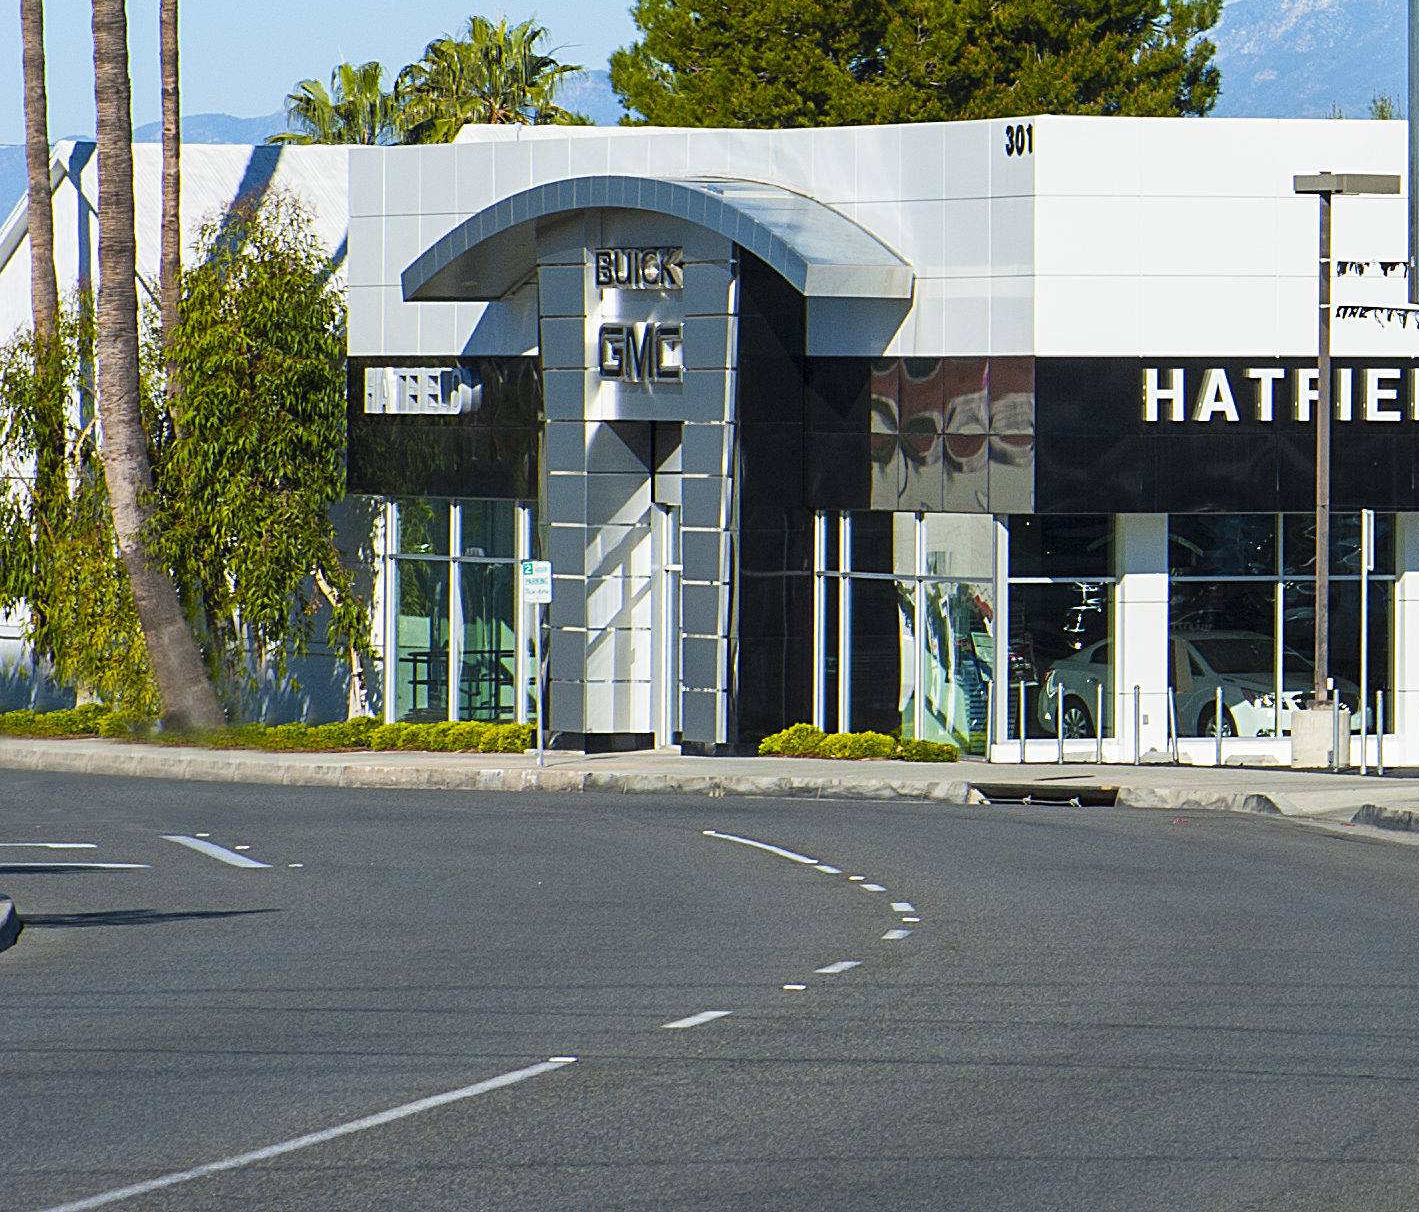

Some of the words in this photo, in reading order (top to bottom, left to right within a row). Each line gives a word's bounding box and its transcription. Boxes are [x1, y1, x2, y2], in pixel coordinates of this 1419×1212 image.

[1005, 123, 1033, 157] 301
[595, 247, 684, 289] BUICK
[600, 322, 684, 384] GMC
[524, 564, 532, 574] 2
